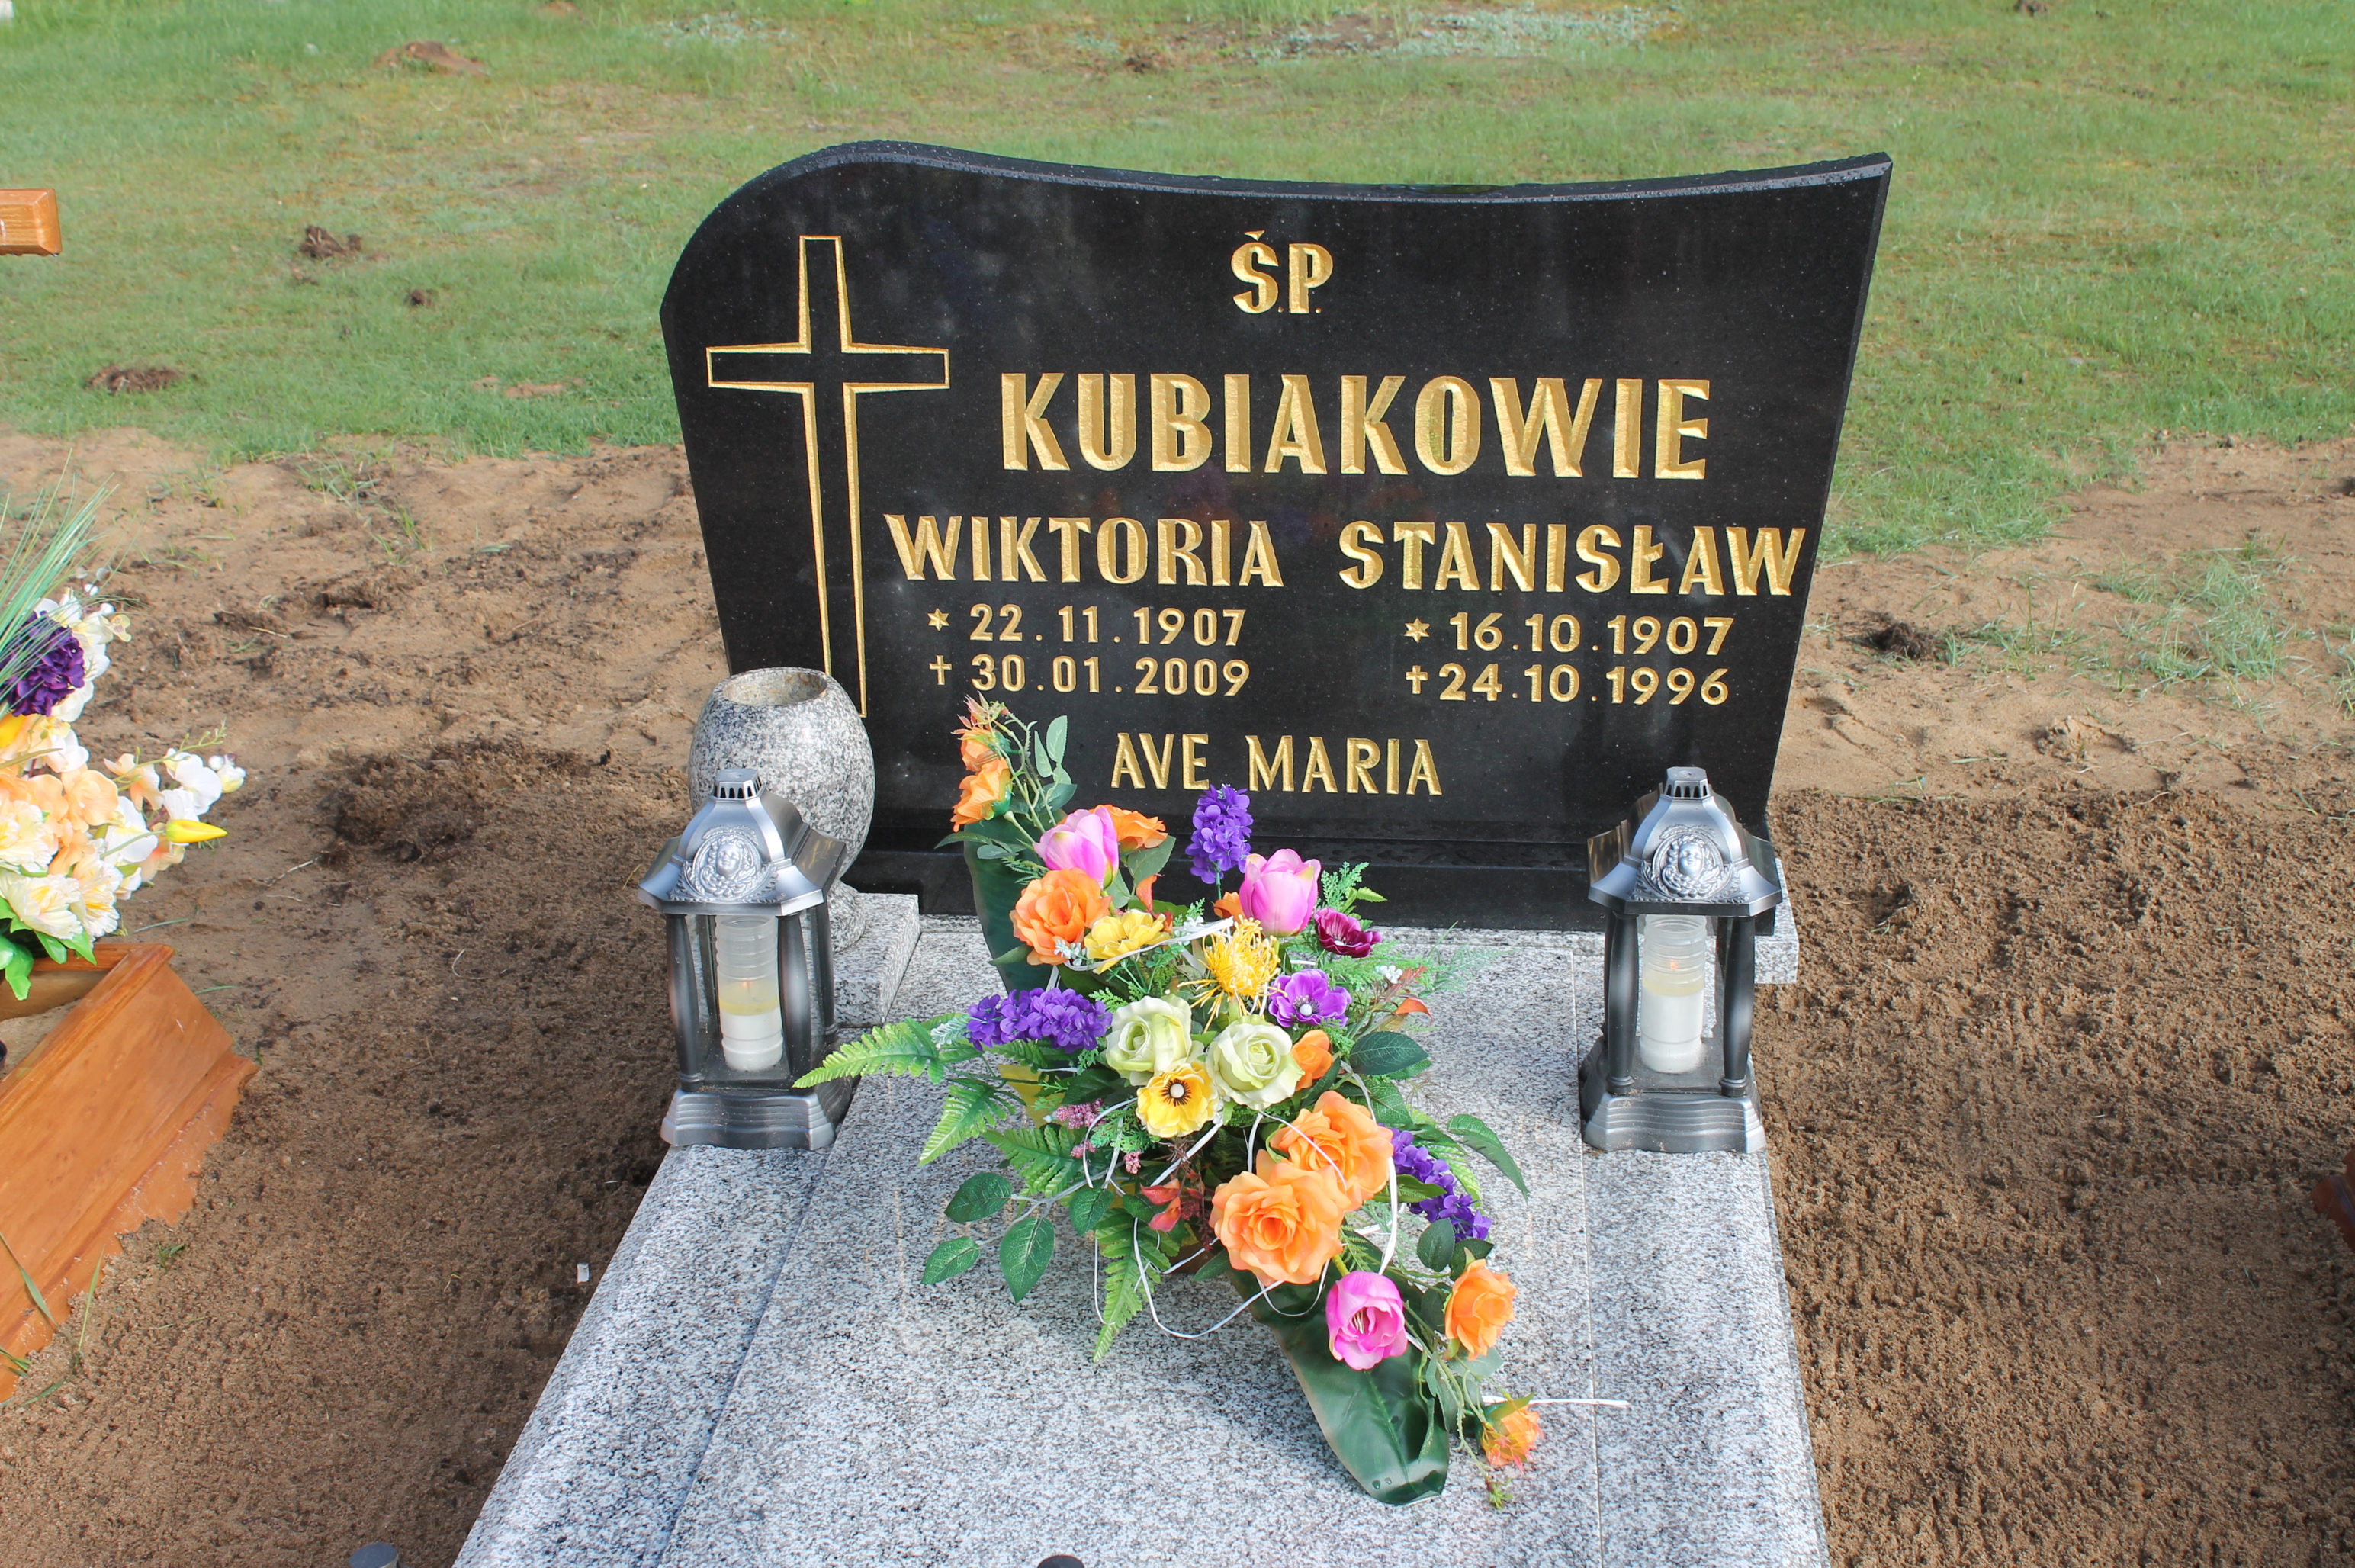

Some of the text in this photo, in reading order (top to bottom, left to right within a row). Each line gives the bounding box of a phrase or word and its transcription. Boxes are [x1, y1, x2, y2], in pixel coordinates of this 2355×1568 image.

[1001, 372, 1711, 480] KUBIAKOWIE
[883, 514, 1806, 596] WIKTORIA STANISŁAW
[1110, 732, 1443, 795] AVE MARIA
